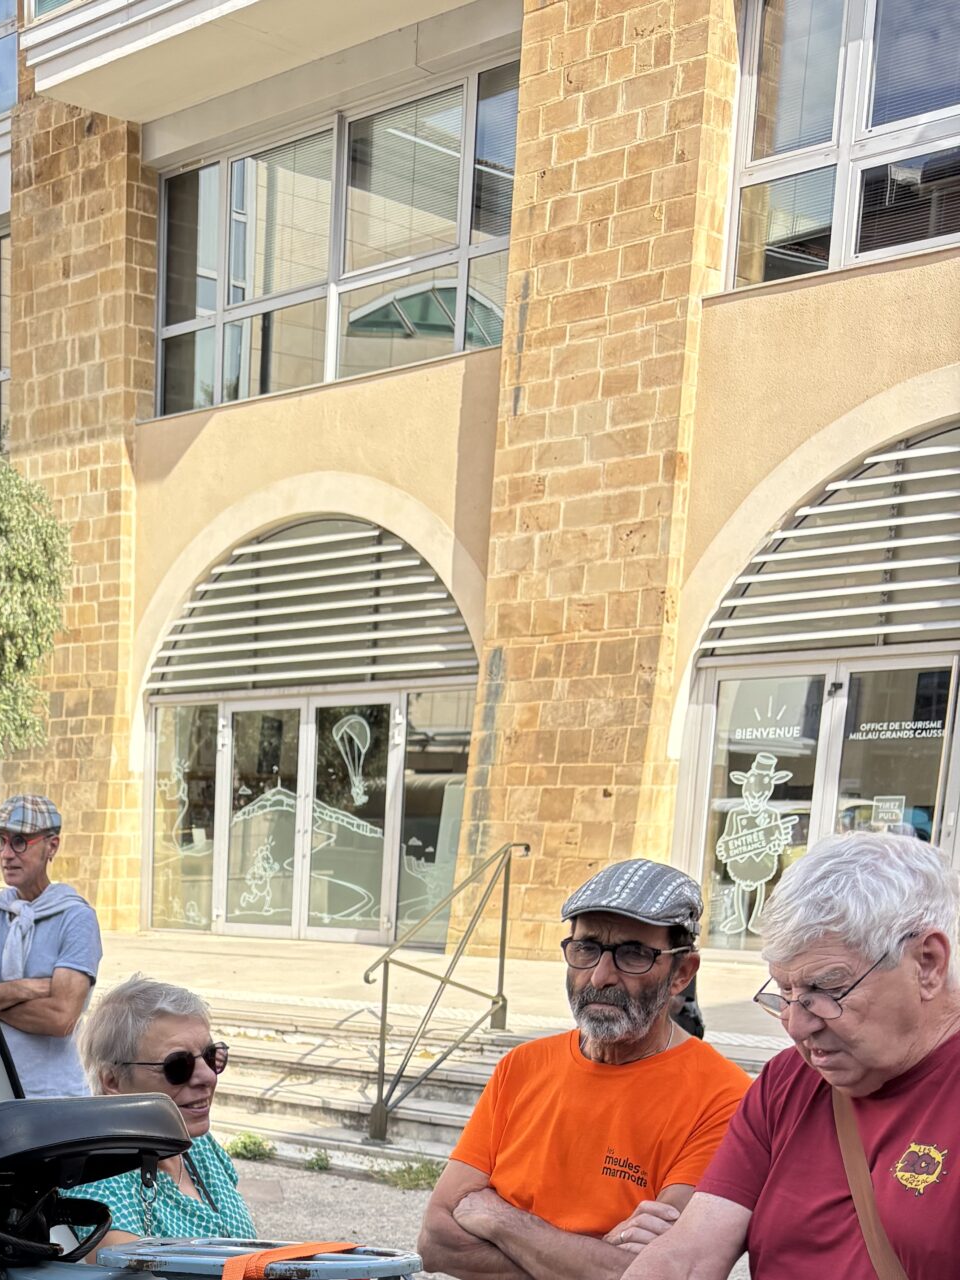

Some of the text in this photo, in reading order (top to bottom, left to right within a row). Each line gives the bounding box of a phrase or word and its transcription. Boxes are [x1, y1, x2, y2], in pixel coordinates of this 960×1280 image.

[860, 720, 942, 731] OFFICE DE TOURISME
[735, 726, 800, 740] BIENVENUE
[849, 731, 879, 741] MILLAU
[880, 730, 914, 739] GRANDS
[878, 812, 896, 820] PULL
[604, 1155, 641, 1174] meules
